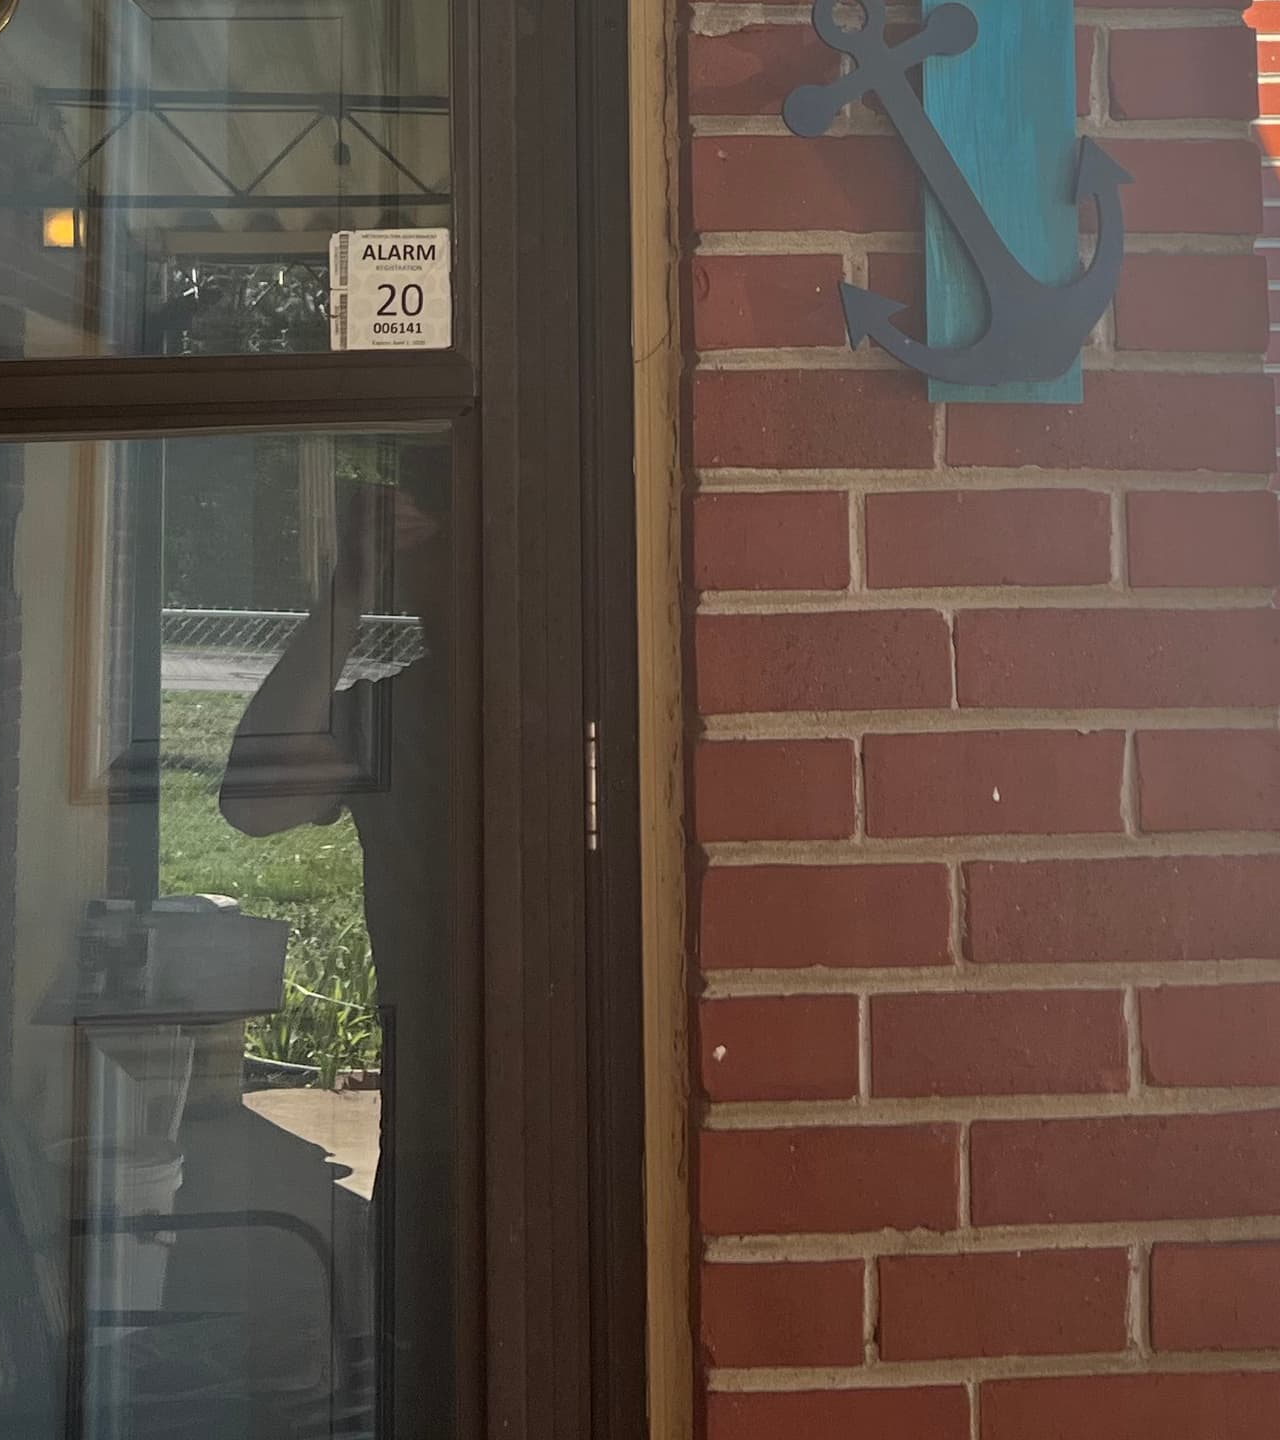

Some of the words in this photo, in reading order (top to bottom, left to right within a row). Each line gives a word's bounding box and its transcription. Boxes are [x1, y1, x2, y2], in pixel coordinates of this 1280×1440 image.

[362, 244, 436, 261] ALARM
[376, 283, 424, 317] 20
[373, 322, 422, 334] 006141
